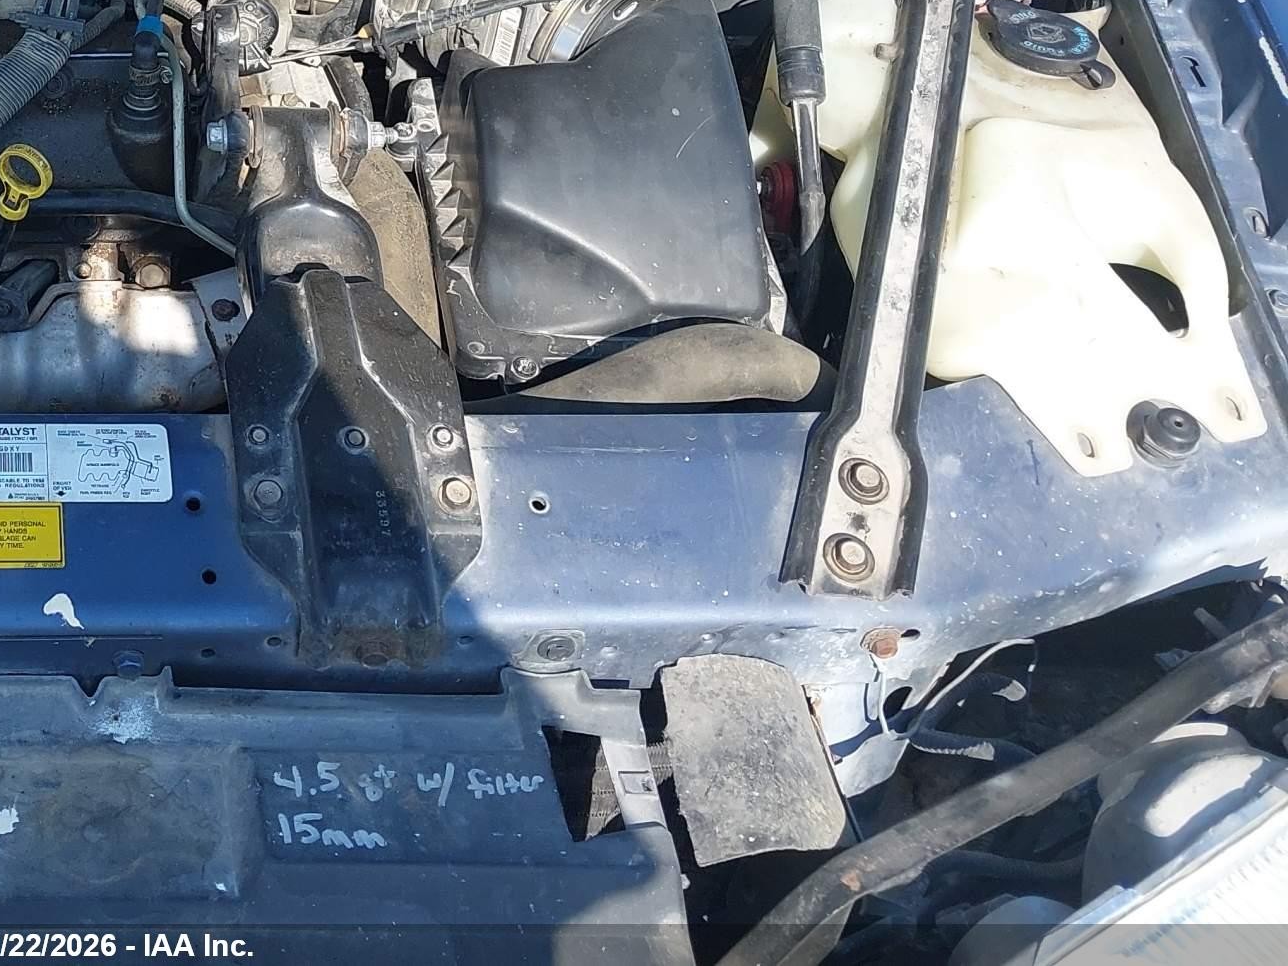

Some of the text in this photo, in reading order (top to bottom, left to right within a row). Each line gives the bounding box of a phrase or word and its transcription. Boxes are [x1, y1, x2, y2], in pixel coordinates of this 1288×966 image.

[273, 761, 342, 798] 4.5
[416, 761, 455, 808] w/
[277, 812, 388, 849] 15mm
